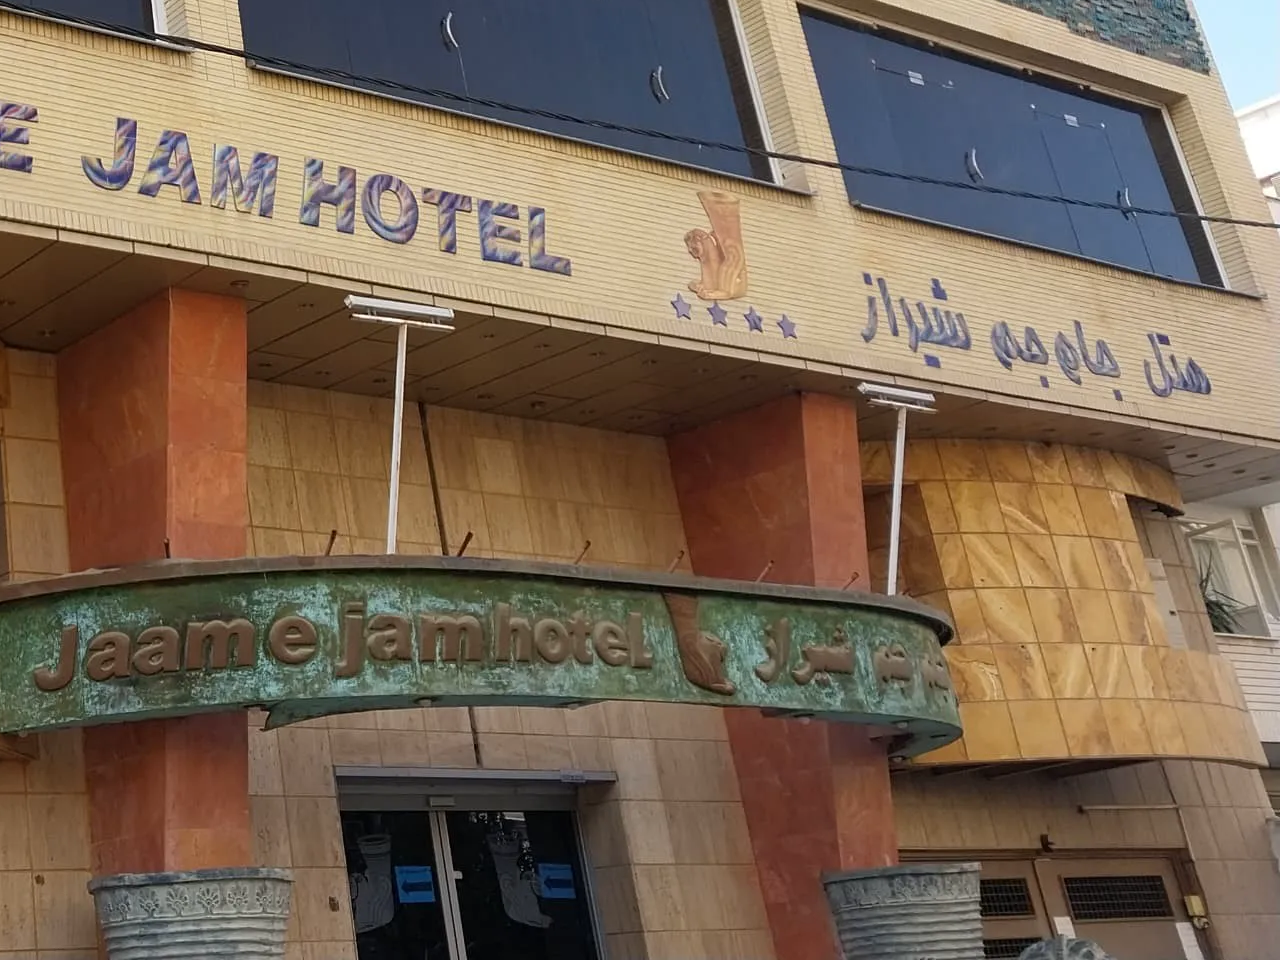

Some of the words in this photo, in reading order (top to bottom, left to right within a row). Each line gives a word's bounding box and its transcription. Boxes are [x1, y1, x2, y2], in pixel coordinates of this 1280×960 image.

[80, 116, 280, 219] JAM
[299, 155, 573, 277] HOTEL
[860, 272, 972, 369] شیراز
[990, 320, 1050, 389] جم
[1054, 320, 1123, 402] جام
[1142, 332, 1212, 398] هتل
[33, 617, 256, 692] Jaam
[268, 614, 318, 665] e
[333, 601, 485, 678] jam
